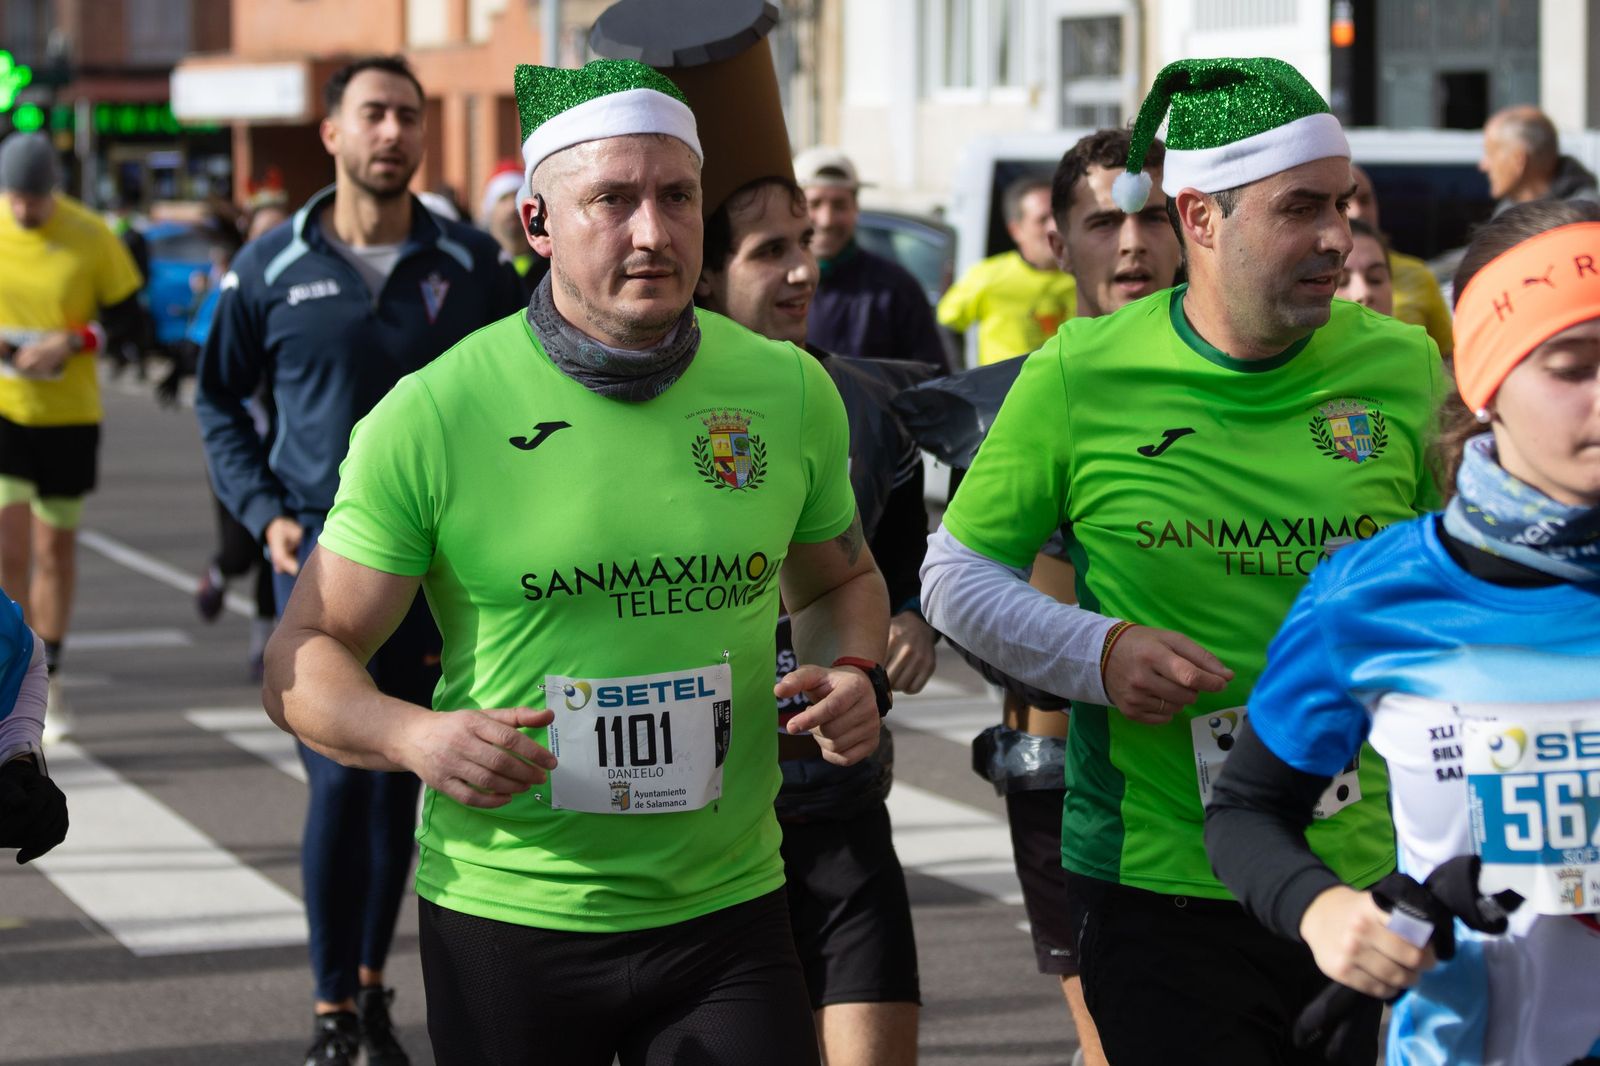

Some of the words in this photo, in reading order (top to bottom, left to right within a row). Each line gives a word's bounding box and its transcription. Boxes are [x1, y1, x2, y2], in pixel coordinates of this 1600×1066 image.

[1135, 514, 1379, 549] SANMAXIMO
[520, 551, 769, 601] SANMAXIMO
[609, 583, 751, 619] TELECOM
[597, 676, 716, 708] SETEL
[594, 711, 673, 768] 1101
[1429, 724, 1455, 742] XLI
[1536, 731, 1600, 762] SE
[608, 766, 664, 779] DANIELO
[634, 788, 687, 798] Ayuntamiento
[634, 800, 645, 809] de
[646, 798, 687, 809] Salamanca
